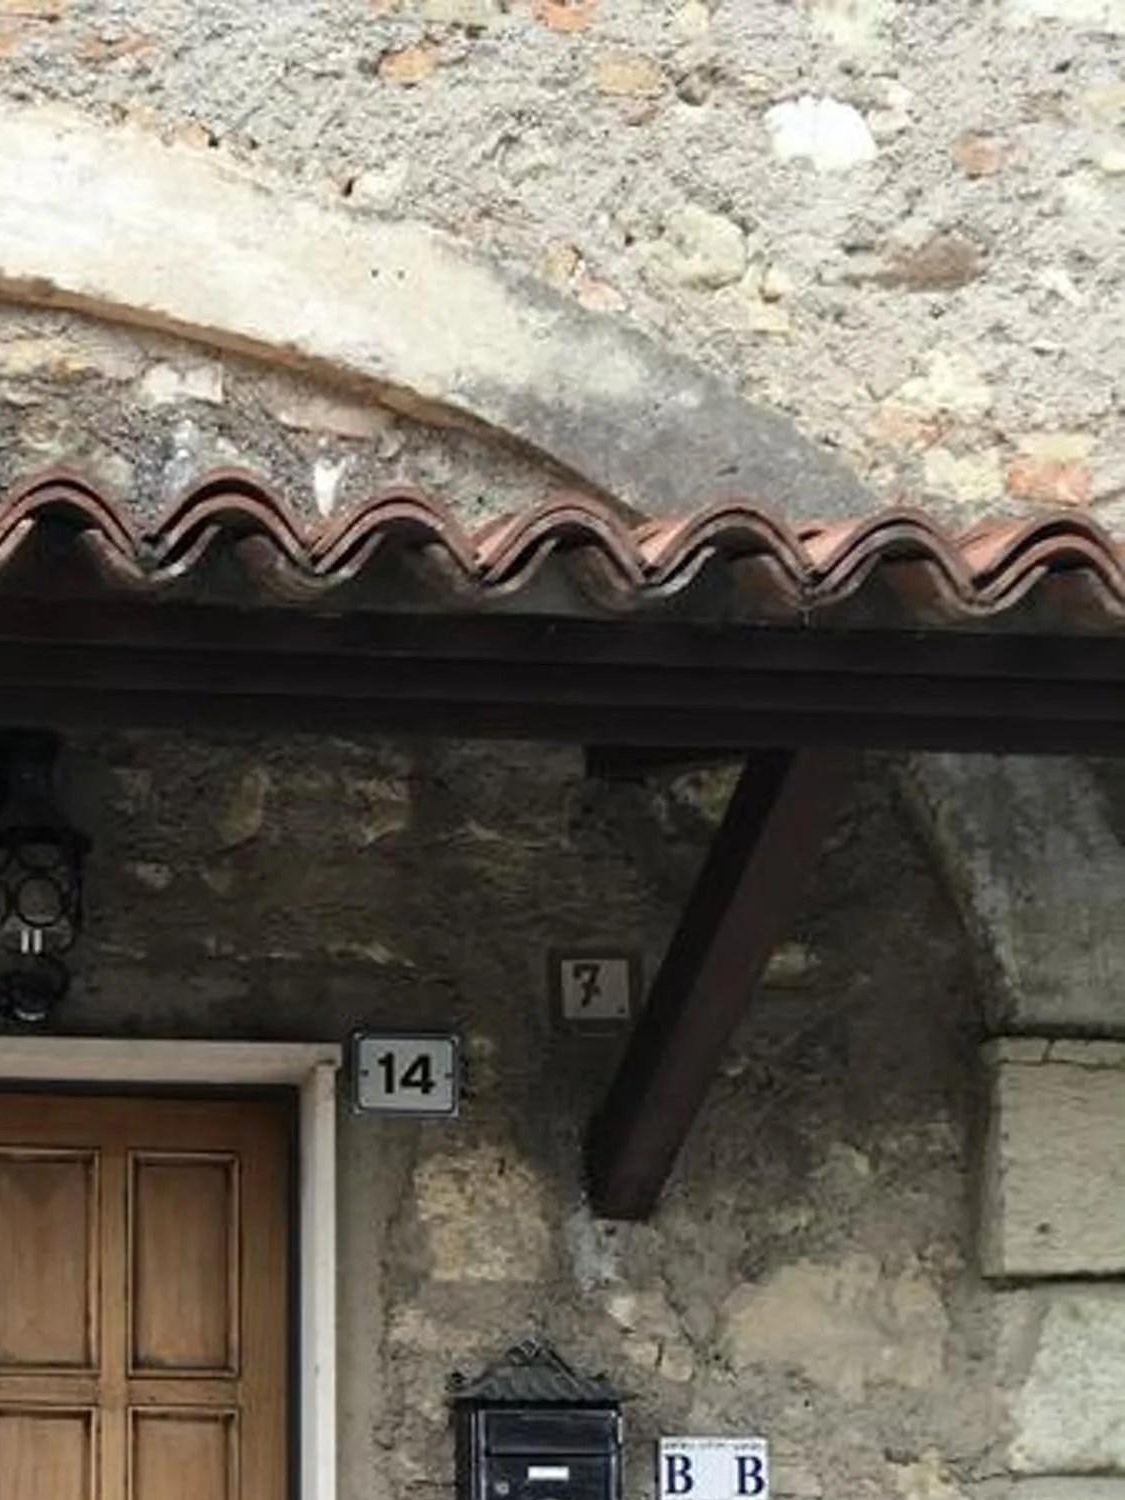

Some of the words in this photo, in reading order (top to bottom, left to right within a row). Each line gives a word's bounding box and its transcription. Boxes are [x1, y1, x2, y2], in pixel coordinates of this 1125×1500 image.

[573, 963, 602, 1008] 7
[377, 1051, 436, 1095] 14
[665, 1453, 694, 1495] B
[735, 1455, 766, 1497] B
